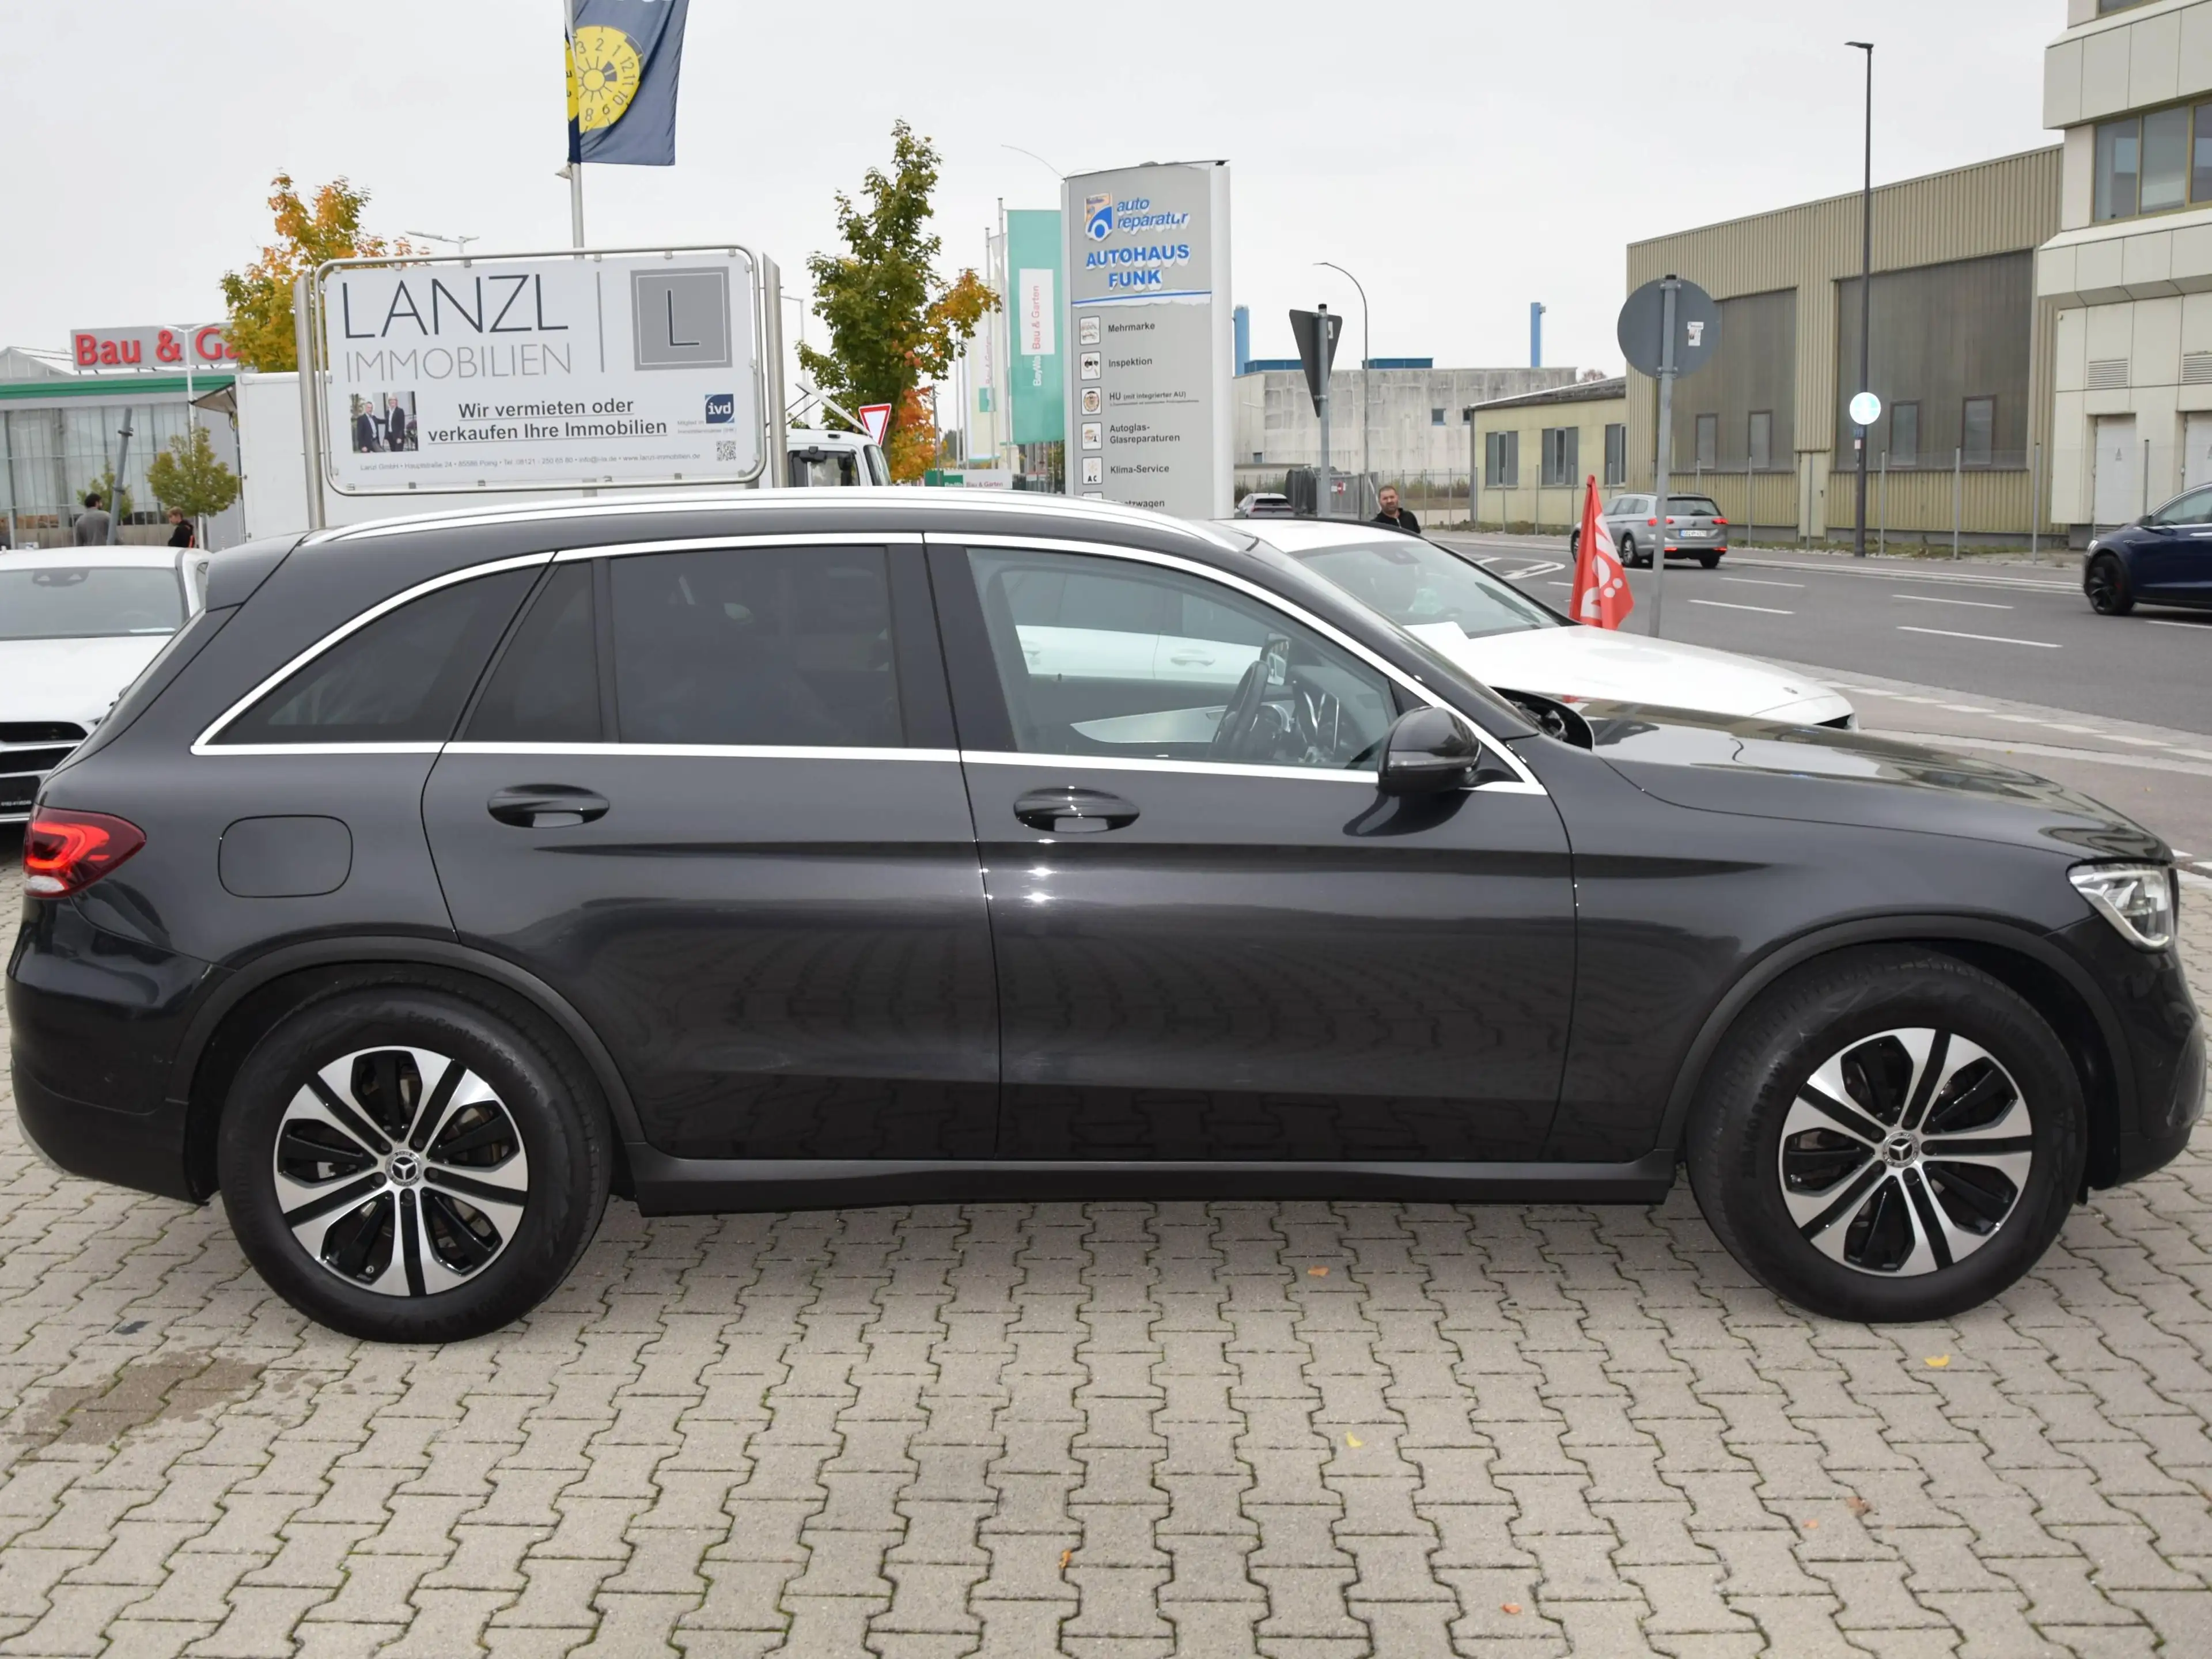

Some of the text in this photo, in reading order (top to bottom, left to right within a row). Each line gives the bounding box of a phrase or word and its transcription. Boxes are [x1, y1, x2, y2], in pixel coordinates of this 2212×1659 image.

[594, 38, 604, 52] 2
[620, 56, 634, 73] 12
[622, 74, 636, 86] 11
[612, 90, 628, 105] 10
[585, 108, 593, 122] 8
[1117, 197, 1150, 212] auto
[1118, 211, 1189, 230] reparatur
[1086, 244, 1190, 267] AUTOHAUS
[1108, 269, 1161, 288] FUNK
[342, 274, 569, 339] LANZL
[1031, 286, 1041, 319] Garten
[666, 290, 699, 346] L
[1108, 321, 1155, 333] Mehrmarke
[76, 334, 141, 365] Bau
[156, 330, 182, 362] &
[1032, 331, 1041, 350] Bau
[346, 342, 571, 383] IMMOBILIEN
[1108, 357, 1152, 369] Inspektion
[1109, 392, 1121, 400] HU
[1137, 392, 1172, 400] integrierter
[459, 398, 634, 419] Wir vermieten oder
[708, 402, 732, 415] ivd
[428, 425, 518, 441] verkaufen
[524, 423, 559, 438] Ihre
[565, 419, 667, 437] Immobilien
[1109, 423, 1150, 434] Autoglas-
[1109, 434, 1180, 445] Glasreparaturen
[1111, 464, 1170, 474] Klima-Service
